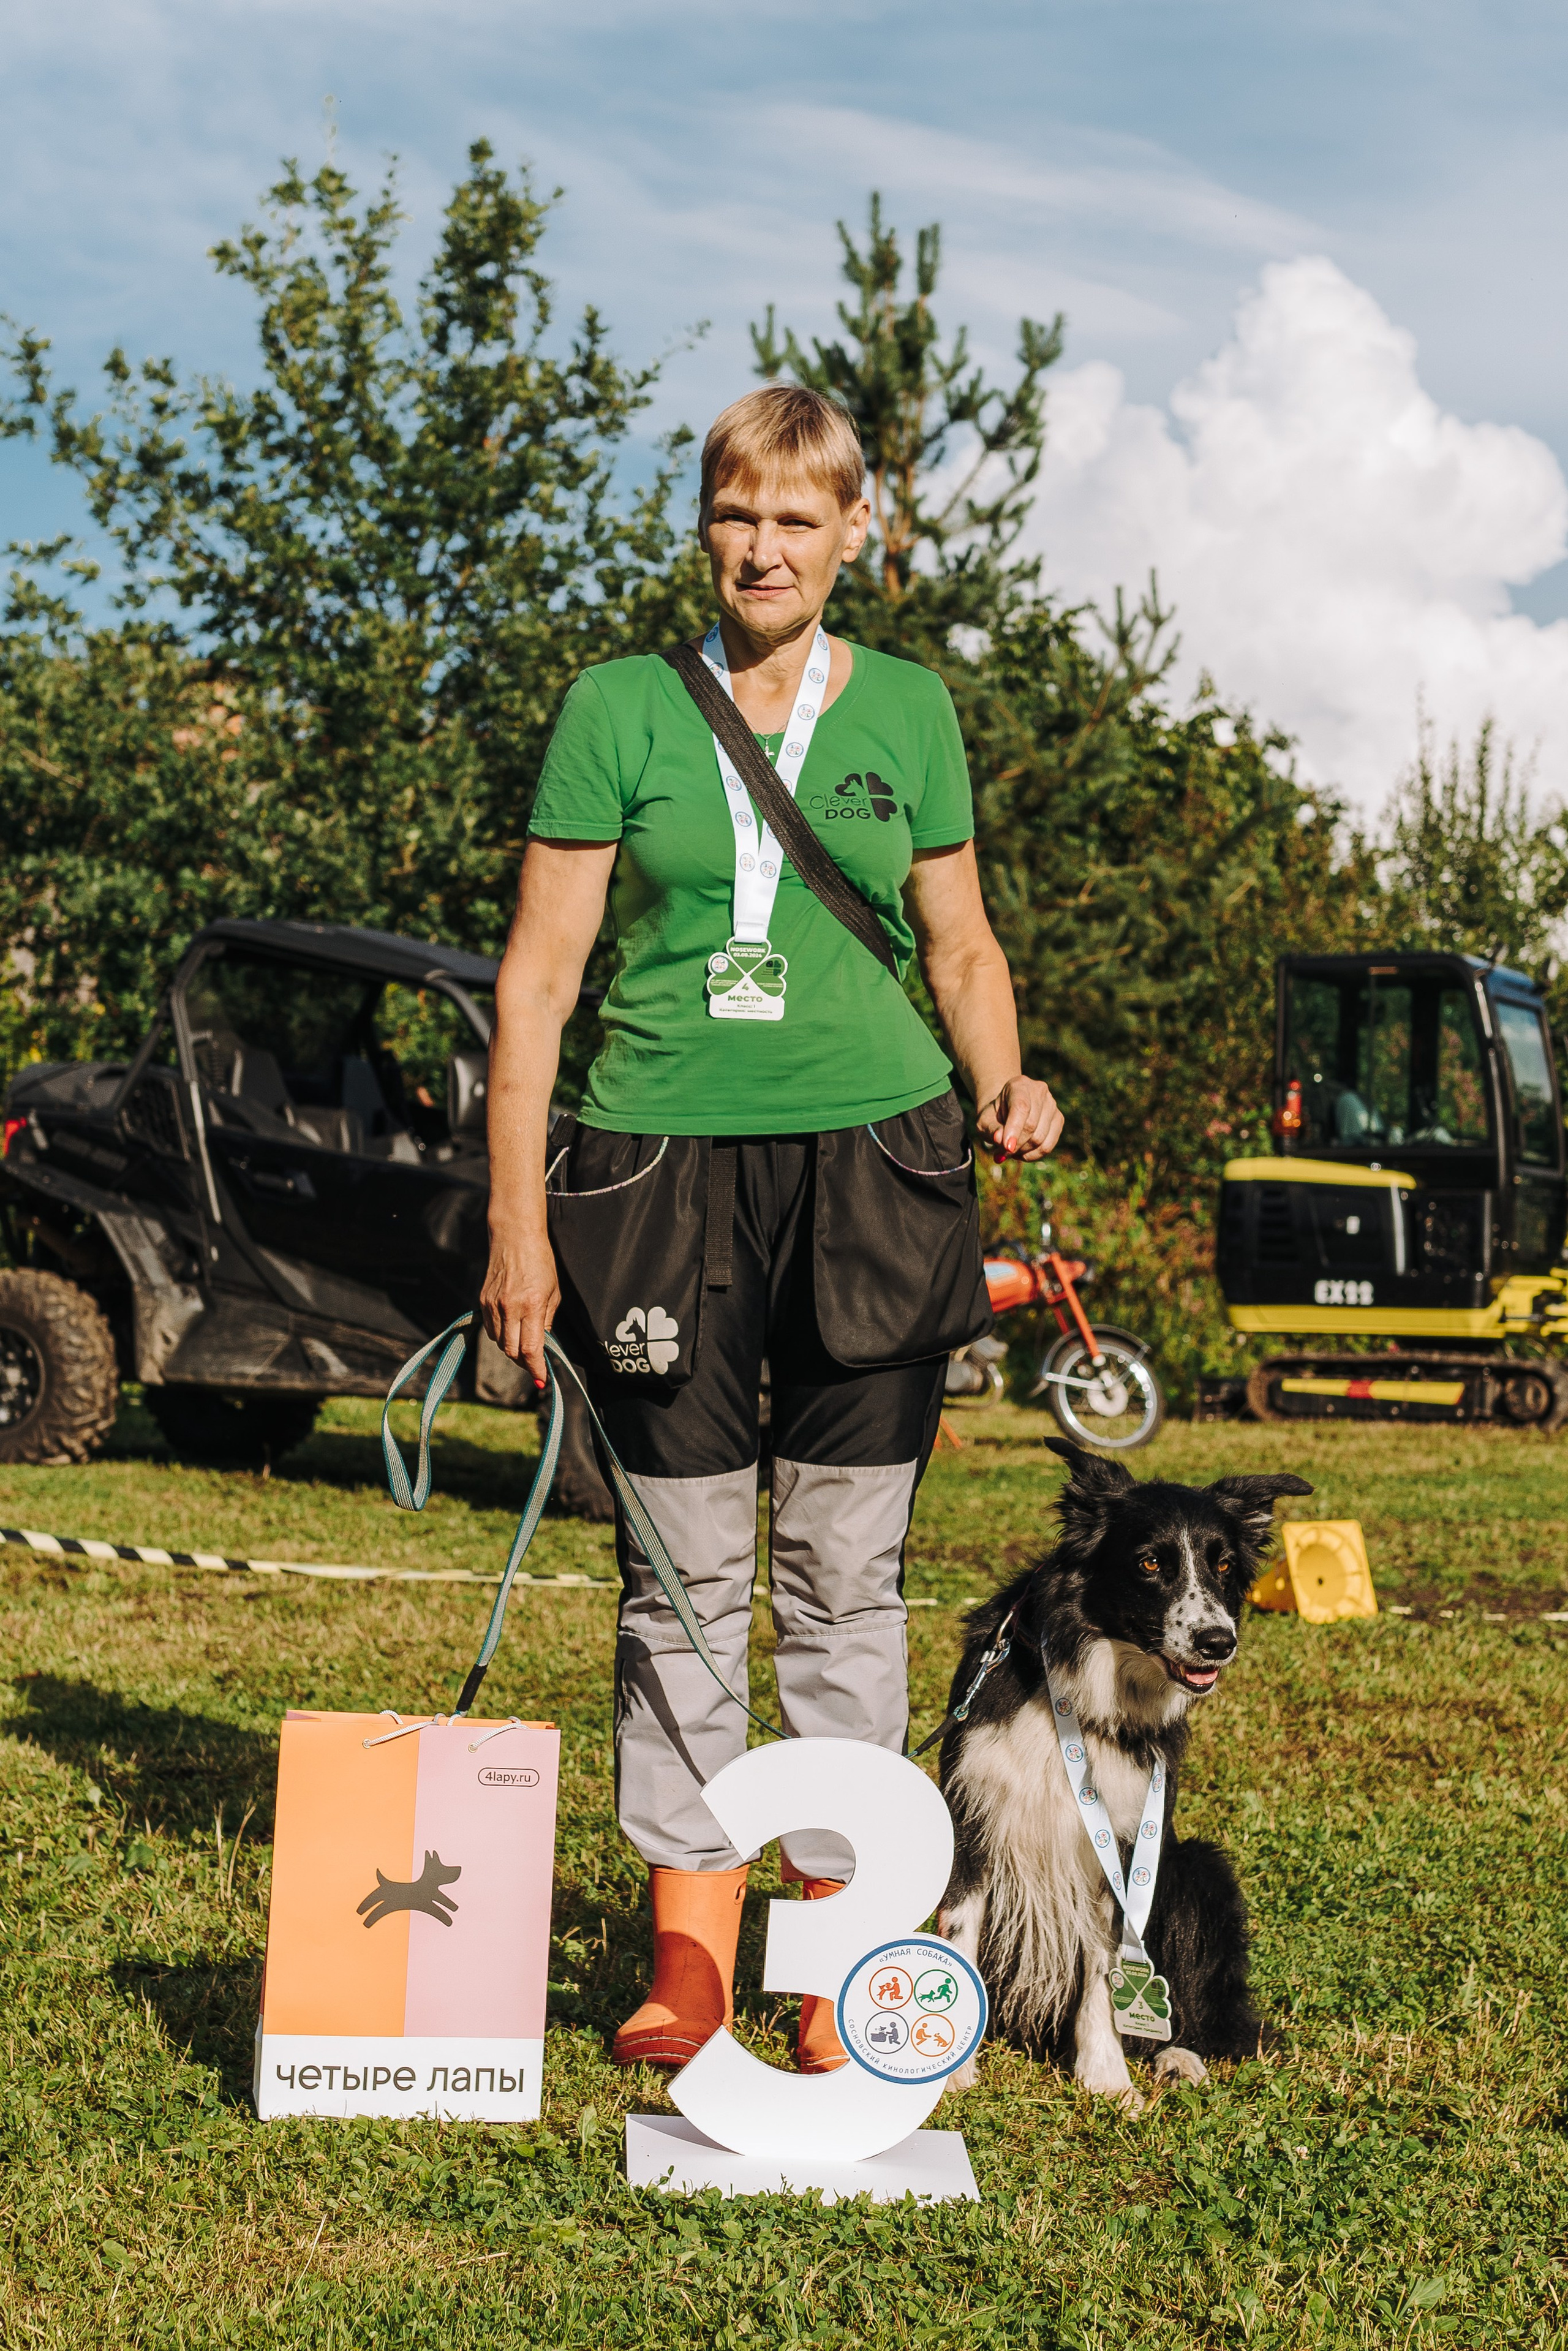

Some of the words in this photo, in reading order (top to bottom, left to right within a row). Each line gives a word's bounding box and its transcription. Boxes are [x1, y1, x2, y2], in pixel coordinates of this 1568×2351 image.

[810, 794, 867, 809] Clever
[825, 807, 870, 820] DOG
[597, 1340, 645, 1357] lever
[485, 1772, 531, 1784] 4lapy.ru
[668, 1737, 954, 2162] 3
[879, 1948, 911, 1963] «УМНАЯ
[916, 1949, 952, 1967] СОБАКА»
[1129, 2012, 1155, 2022] место
[848, 2018, 880, 2064] СОСНОВСКИЙ
[883, 2051, 956, 2074] КИНОЛОГИЧЕСКИЙ
[957, 2025, 973, 2051] ЦЕНТР
[276, 2064, 417, 2091] четыре
[426, 2067, 524, 2093] лапы
